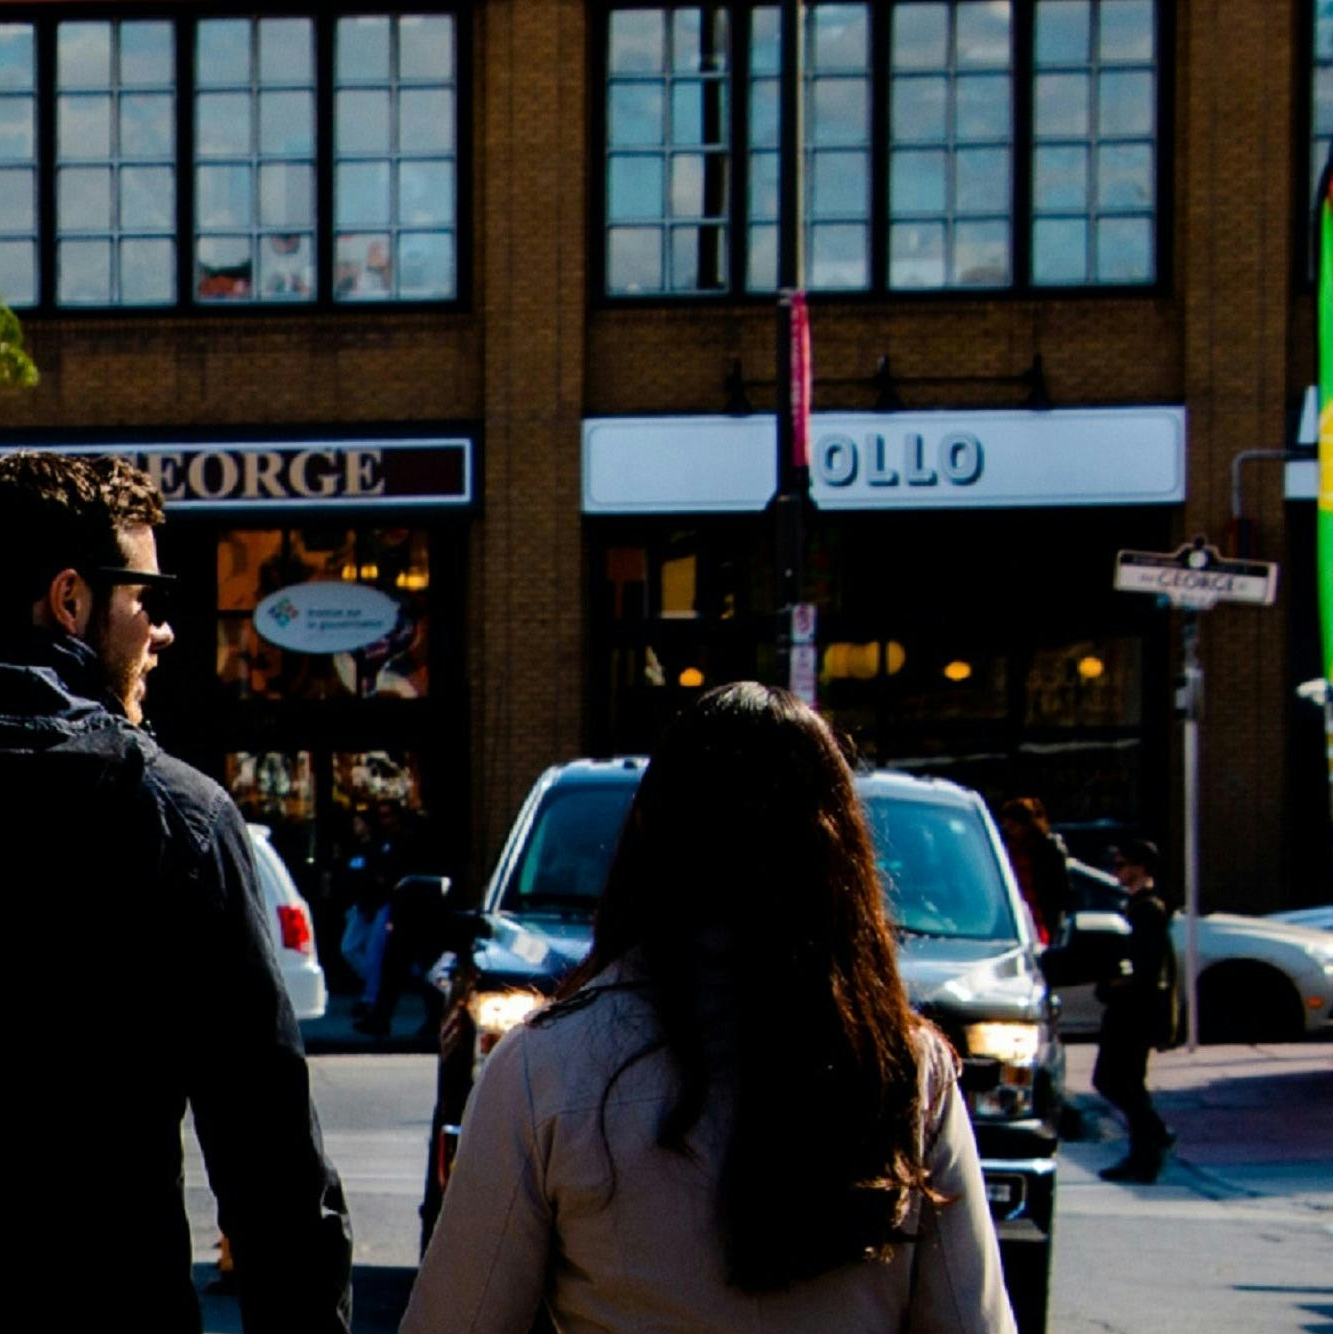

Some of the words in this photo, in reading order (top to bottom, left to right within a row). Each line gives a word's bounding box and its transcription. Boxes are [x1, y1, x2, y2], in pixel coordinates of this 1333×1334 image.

[135, 448, 385, 500] EORGE
[814, 432, 986, 488] OLLO
[1156, 570, 1235, 592] GEORGE
